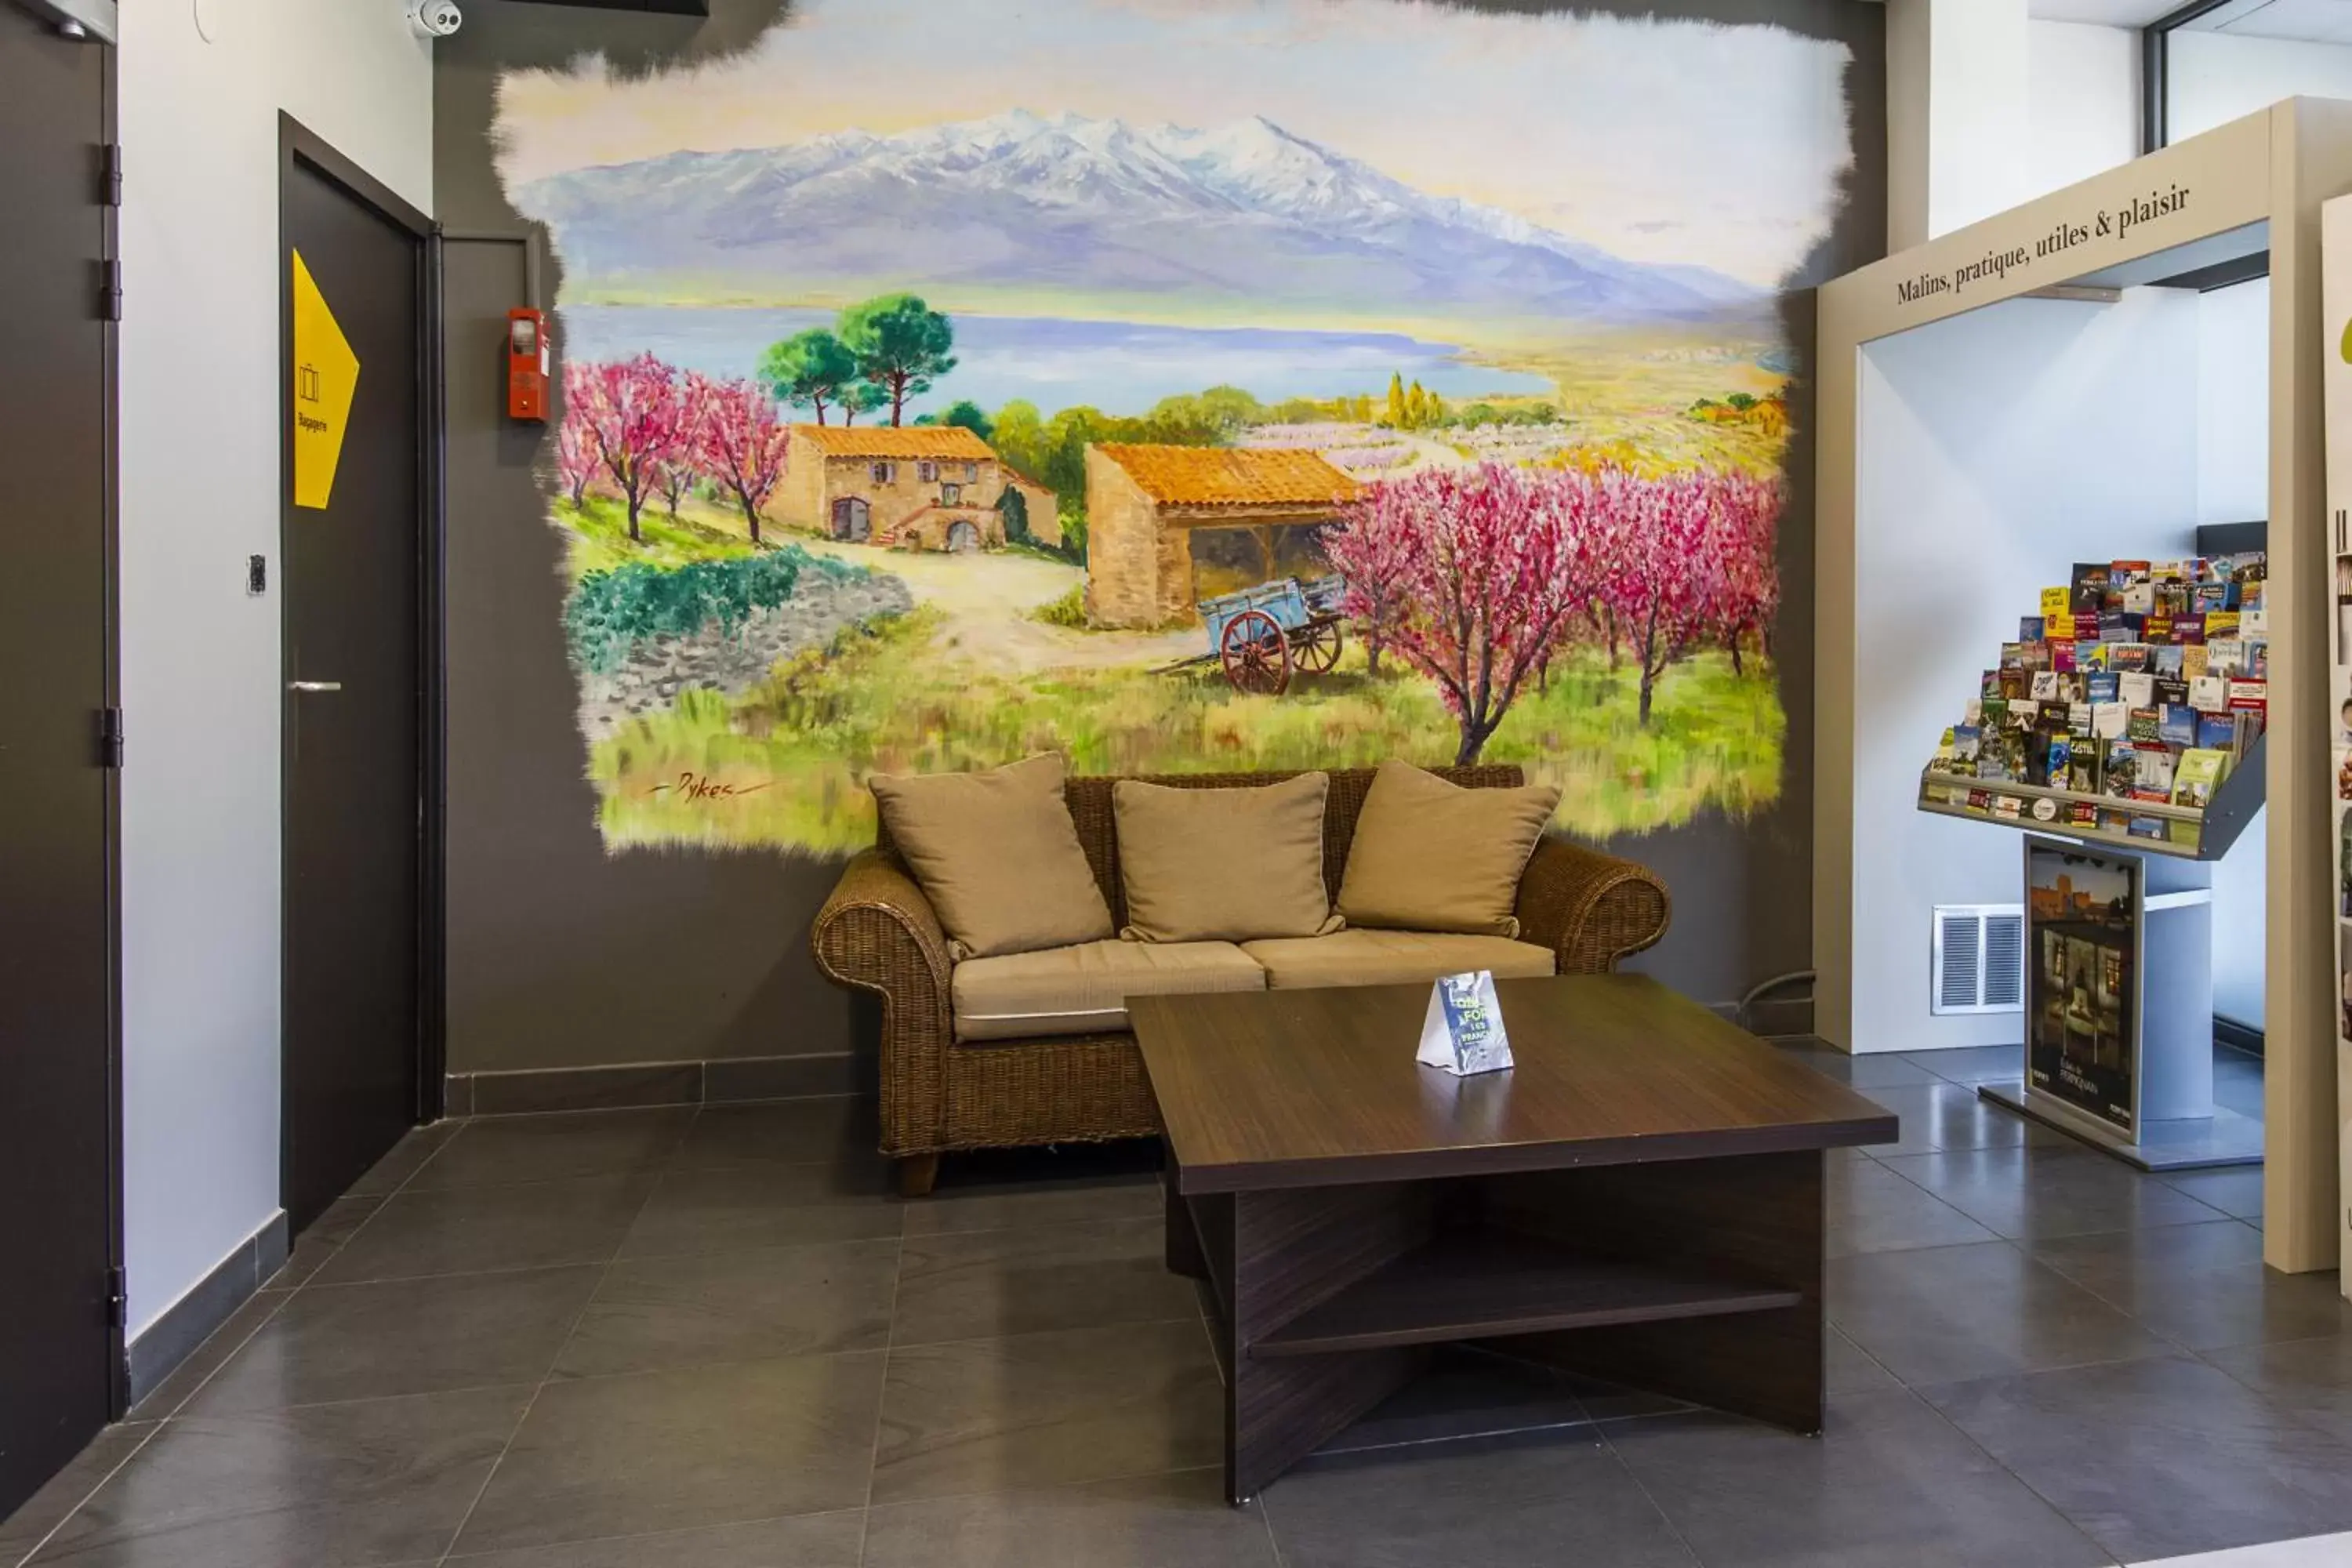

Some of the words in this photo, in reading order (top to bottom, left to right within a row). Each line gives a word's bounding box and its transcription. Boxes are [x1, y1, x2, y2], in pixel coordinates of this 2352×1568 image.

[1897, 273, 1951, 305] Malins,
[1955, 250, 2031, 293] pratique,
[2036, 223, 2089, 259] utiles
[2095, 210, 2112, 238] &
[2118, 183, 2190, 240] plaisir
